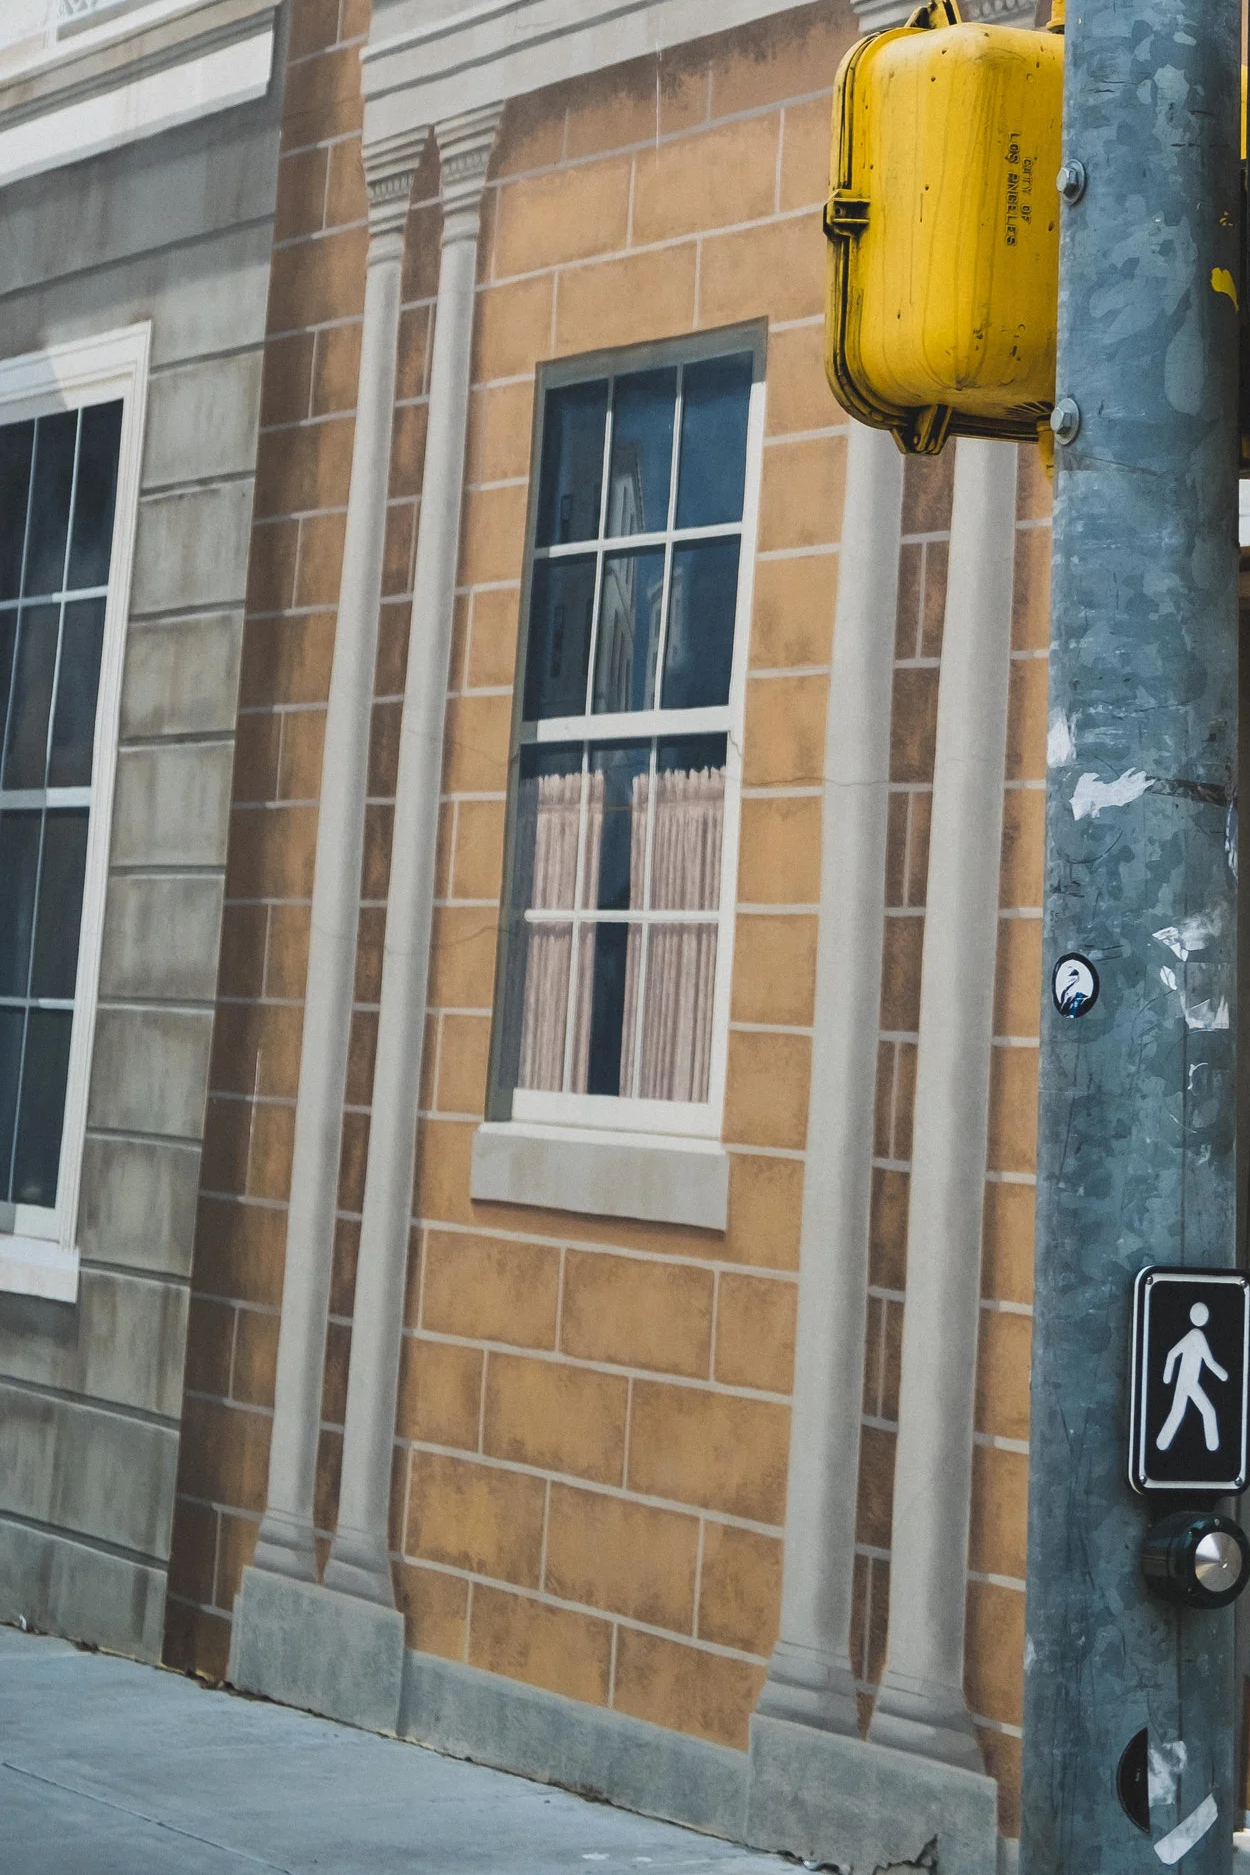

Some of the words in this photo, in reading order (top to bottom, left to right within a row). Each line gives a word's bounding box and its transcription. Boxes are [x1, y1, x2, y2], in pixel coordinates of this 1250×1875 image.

[1008, 132, 1020, 165] LOS
[1022, 157, 1033, 194] CITY
[1006, 173, 1018, 246] ANGELES
[1021, 205, 1032, 224] OF
